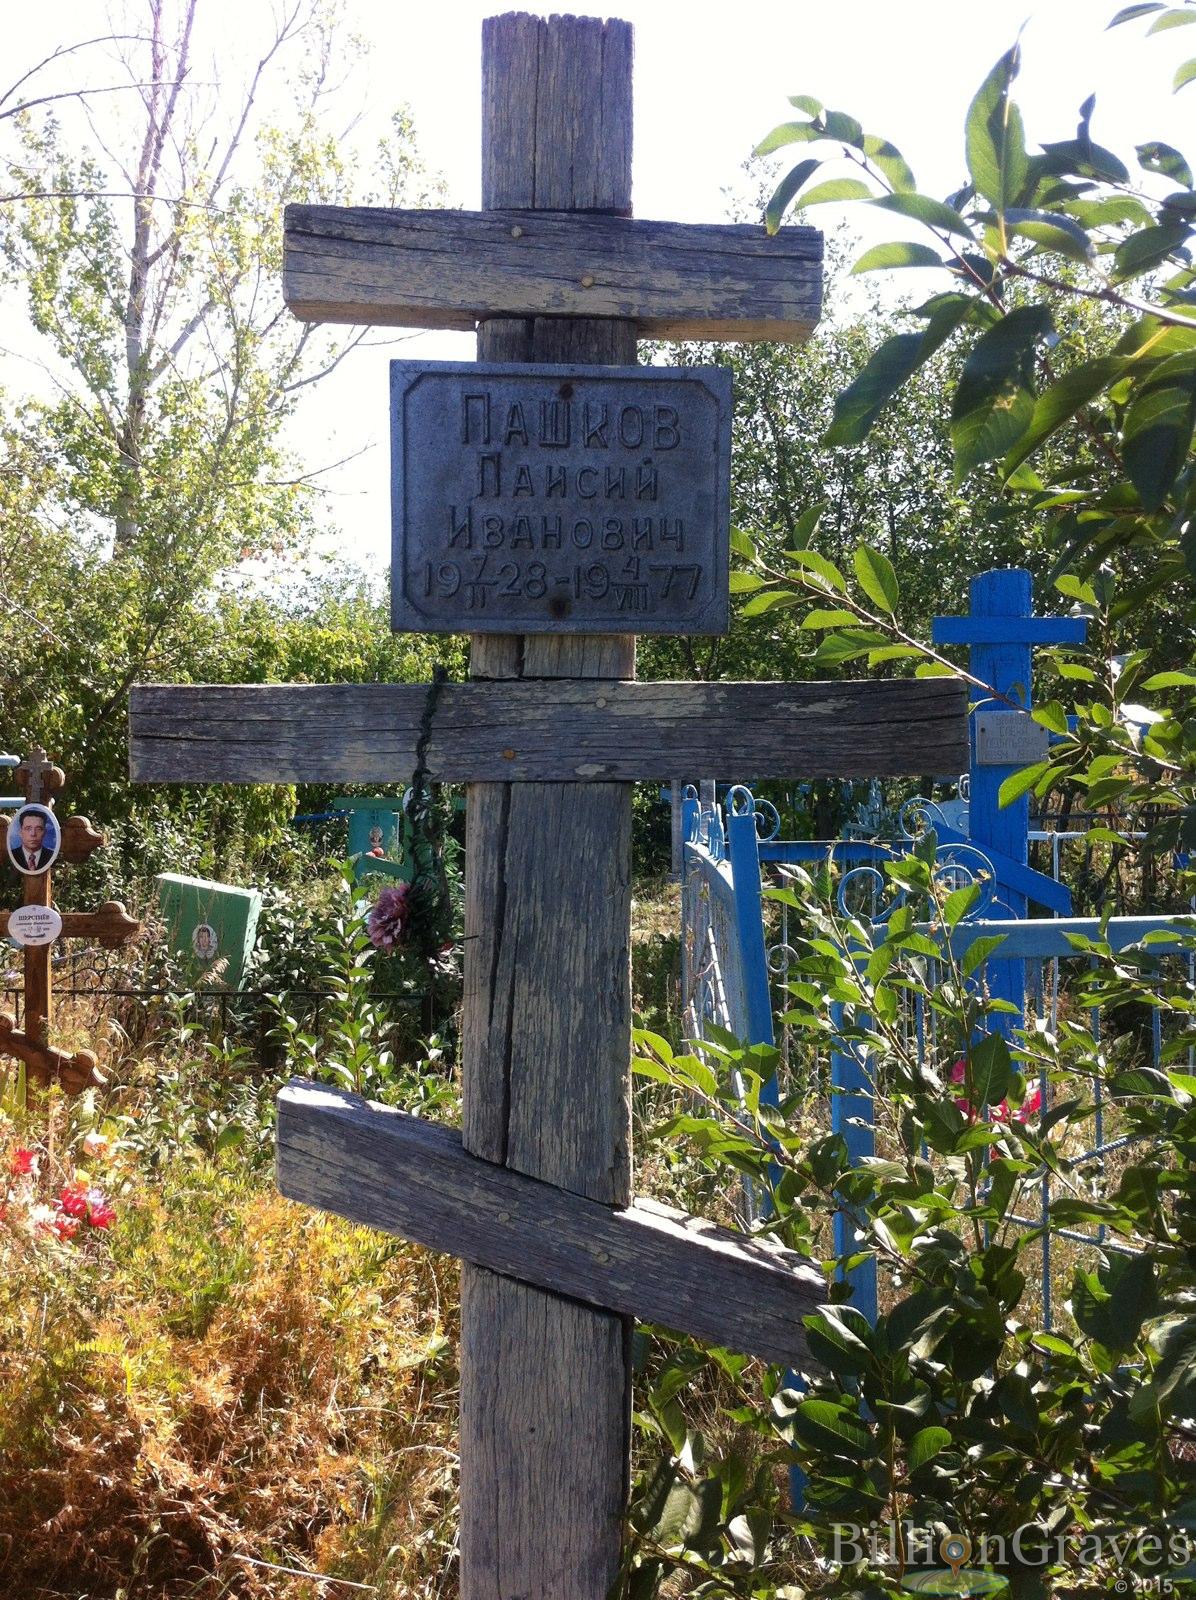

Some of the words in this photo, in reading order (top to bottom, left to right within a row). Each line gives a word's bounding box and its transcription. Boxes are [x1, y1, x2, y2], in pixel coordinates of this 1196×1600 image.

[461, 392, 681, 451] ПАШКОВ
[476, 451, 659, 501] ПАИСИЙ
[447, 504, 684, 552] ИВАНОВИЧ
